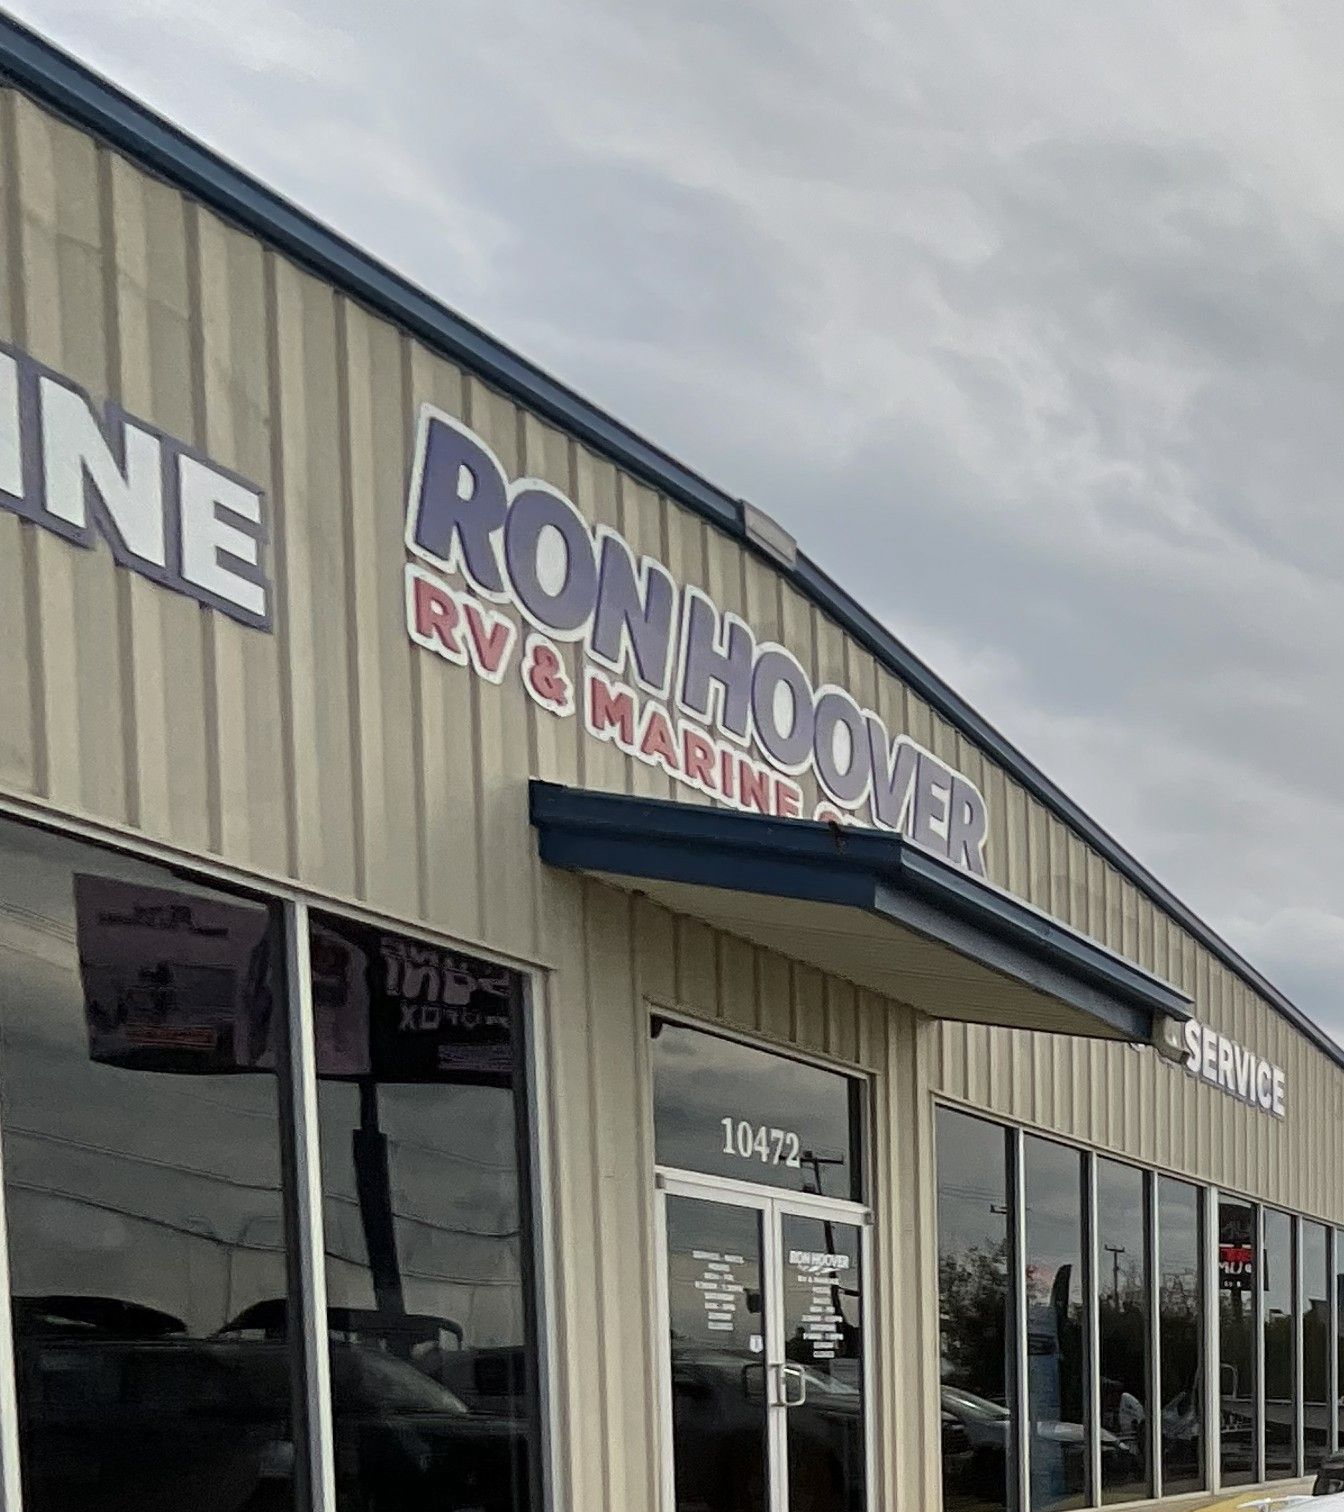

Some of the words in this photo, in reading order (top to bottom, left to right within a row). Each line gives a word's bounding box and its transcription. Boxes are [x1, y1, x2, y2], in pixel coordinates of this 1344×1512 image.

[411, 414, 674, 694] RON
[681, 592, 988, 878] HOOVER
[411, 575, 511, 674] RV
[529, 644, 571, 706] &
[589, 675, 800, 817] MARINE
[720, 1116, 801, 1169] 10472
[1184, 1018, 1286, 1116] SERVICE
